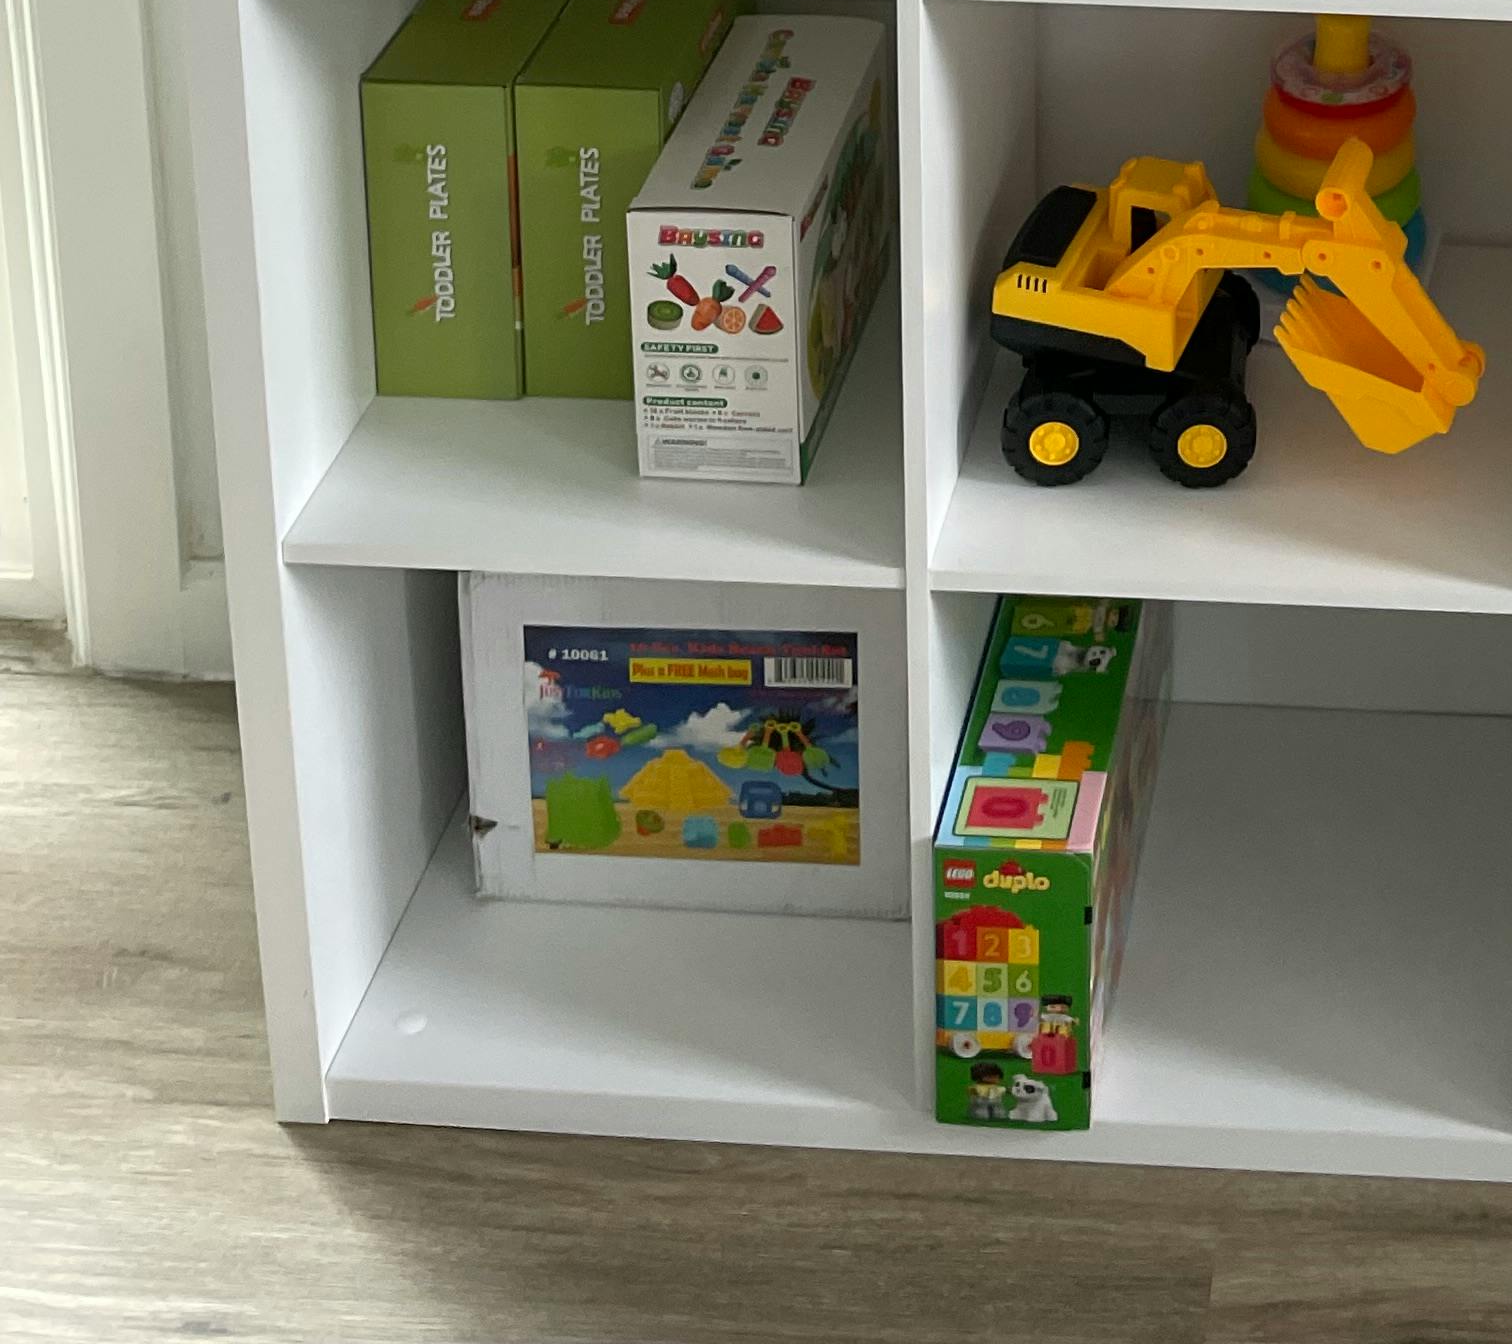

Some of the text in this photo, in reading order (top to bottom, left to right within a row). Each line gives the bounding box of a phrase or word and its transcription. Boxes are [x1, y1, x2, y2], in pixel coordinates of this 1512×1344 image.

[426, 143, 456, 323] TODDLER PLATES
[579, 146, 606, 326] TODDLER PLATES
[644, 343, 715, 354] SAFETY FIRST
[946, 868, 975, 881] LEGO
[982, 869, 1051, 895] duplo
[951, 928, 1032, 959] 1 2 3
[949, 966, 1033, 994] 4 5 6
[952, 1000, 1034, 1029] 7 8 9
